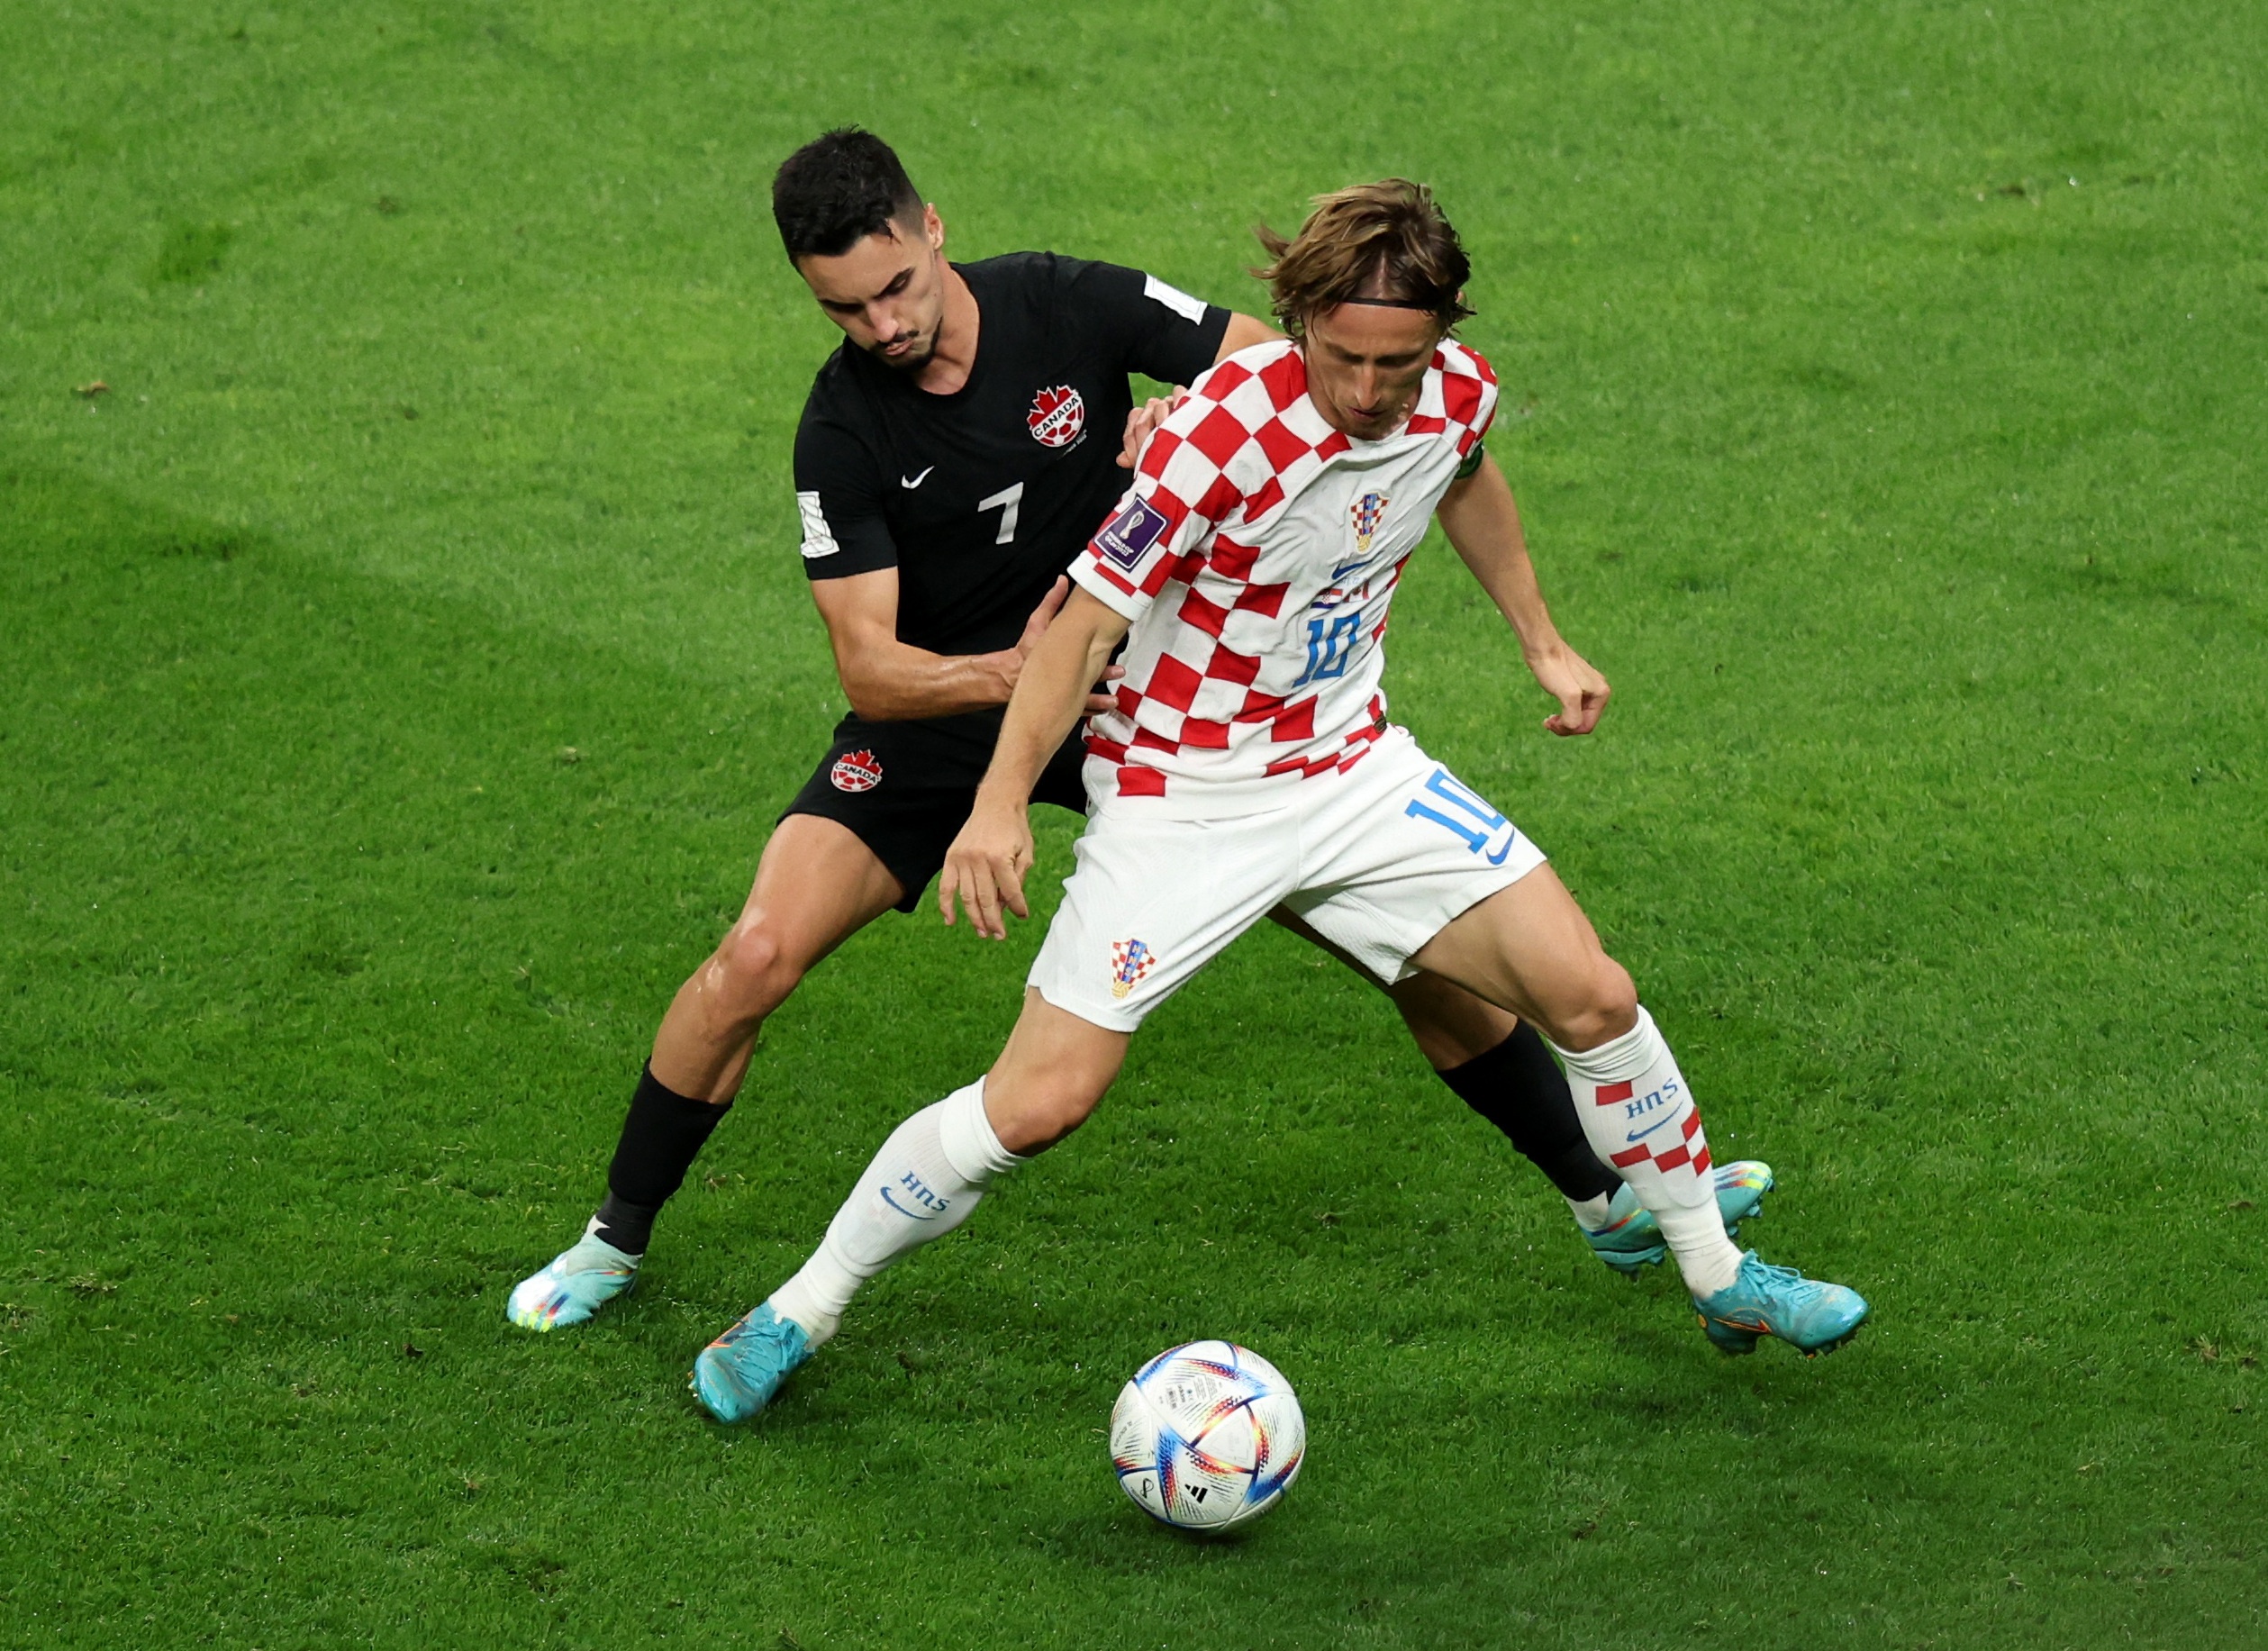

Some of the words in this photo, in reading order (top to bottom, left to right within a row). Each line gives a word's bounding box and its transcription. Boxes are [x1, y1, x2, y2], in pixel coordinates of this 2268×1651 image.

[1034, 397, 1079, 437] CANADA
[977, 481, 1024, 545] 7
[1292, 610, 1361, 689] 10
[835, 764, 876, 783] CANADA
[1404, 768, 1506, 855] 10
